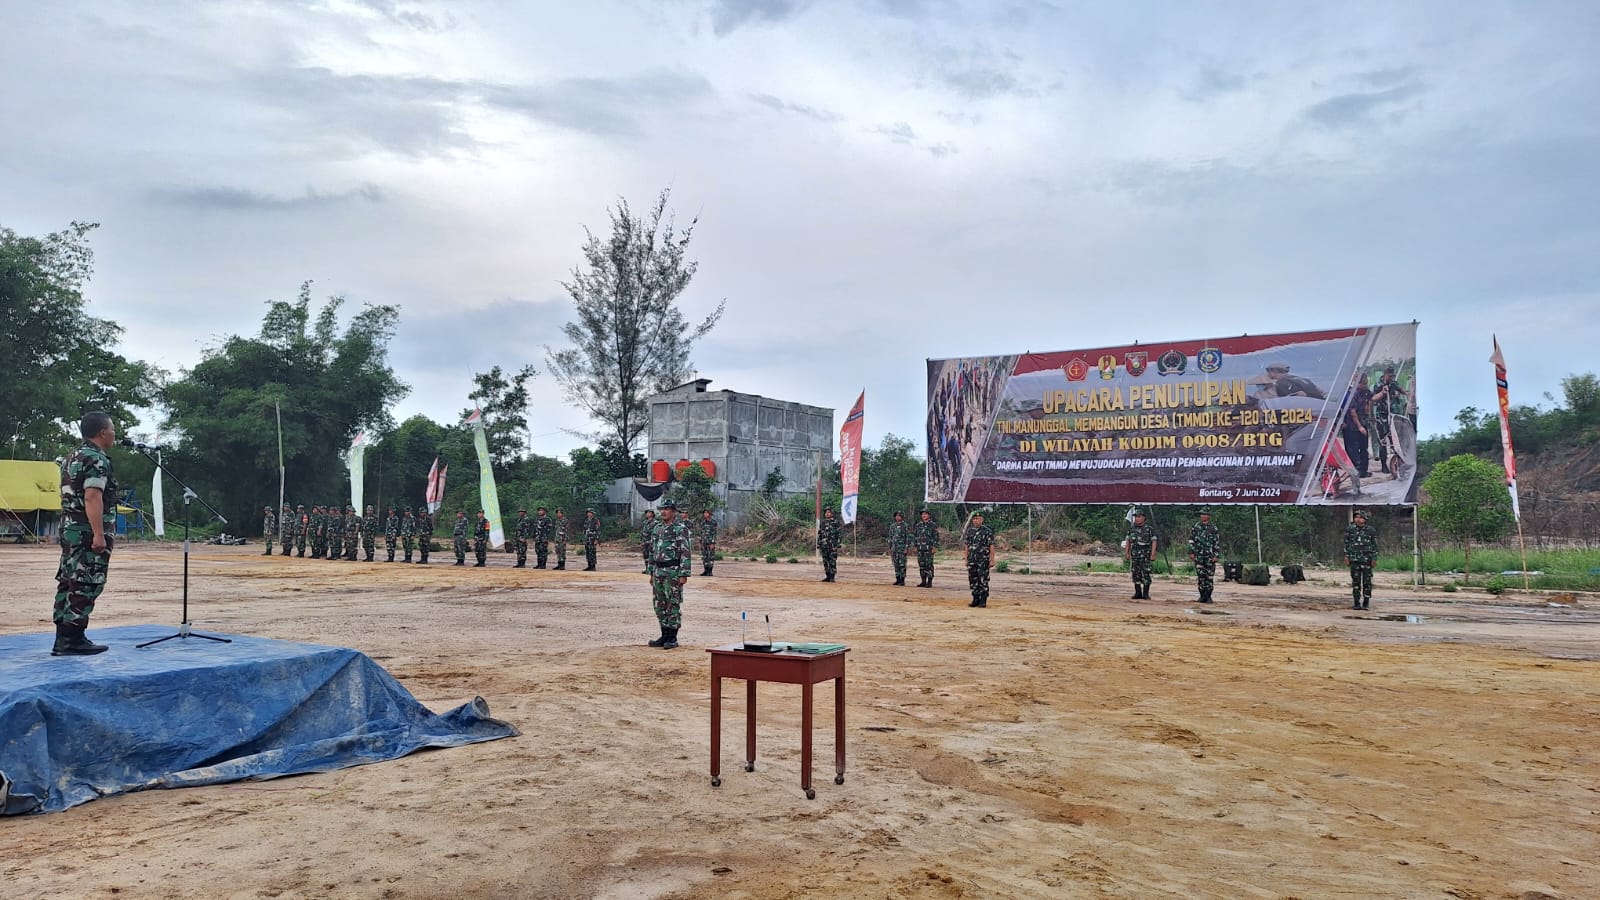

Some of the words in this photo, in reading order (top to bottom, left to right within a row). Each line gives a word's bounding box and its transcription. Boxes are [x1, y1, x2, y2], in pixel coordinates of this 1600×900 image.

[1043, 388, 1124, 413] UPACARA
[1130, 379, 1246, 409] PENUTUPAN
[996, 420, 1011, 434] TNI
[1013, 417, 1072, 433] MANUNGGAL
[1074, 415, 1139, 432] MEMBANGUN
[1140, 413, 1170, 429] DESA
[1172, 411, 1214, 429] (TMMD)
[1216, 410, 1260, 426] KE-120
[1263, 409, 1278, 425] TA
[1281, 408, 1313, 424] 2024
[1019, 440, 1037, 453] DI
[1042, 437, 1113, 452] WILAYAH
[1119, 435, 1176, 451] KODIM
[1182, 432, 1283, 449] 0908/BTG
[1023, 460, 1044, 470] BAKTI
[1045, 460, 1068, 470] TMMD
[1069, 459, 1123, 470] MEWUJUDKAN
[1126, 457, 1176, 468] PERCEPATAN
[1177, 456, 1242, 467] PEMBANGUNAN
[1244, 456, 1255, 466] DI
[1235, 488, 1241, 497] 7
[1241, 488, 1259, 497] Juni
[1260, 488, 1280, 497] 2024
